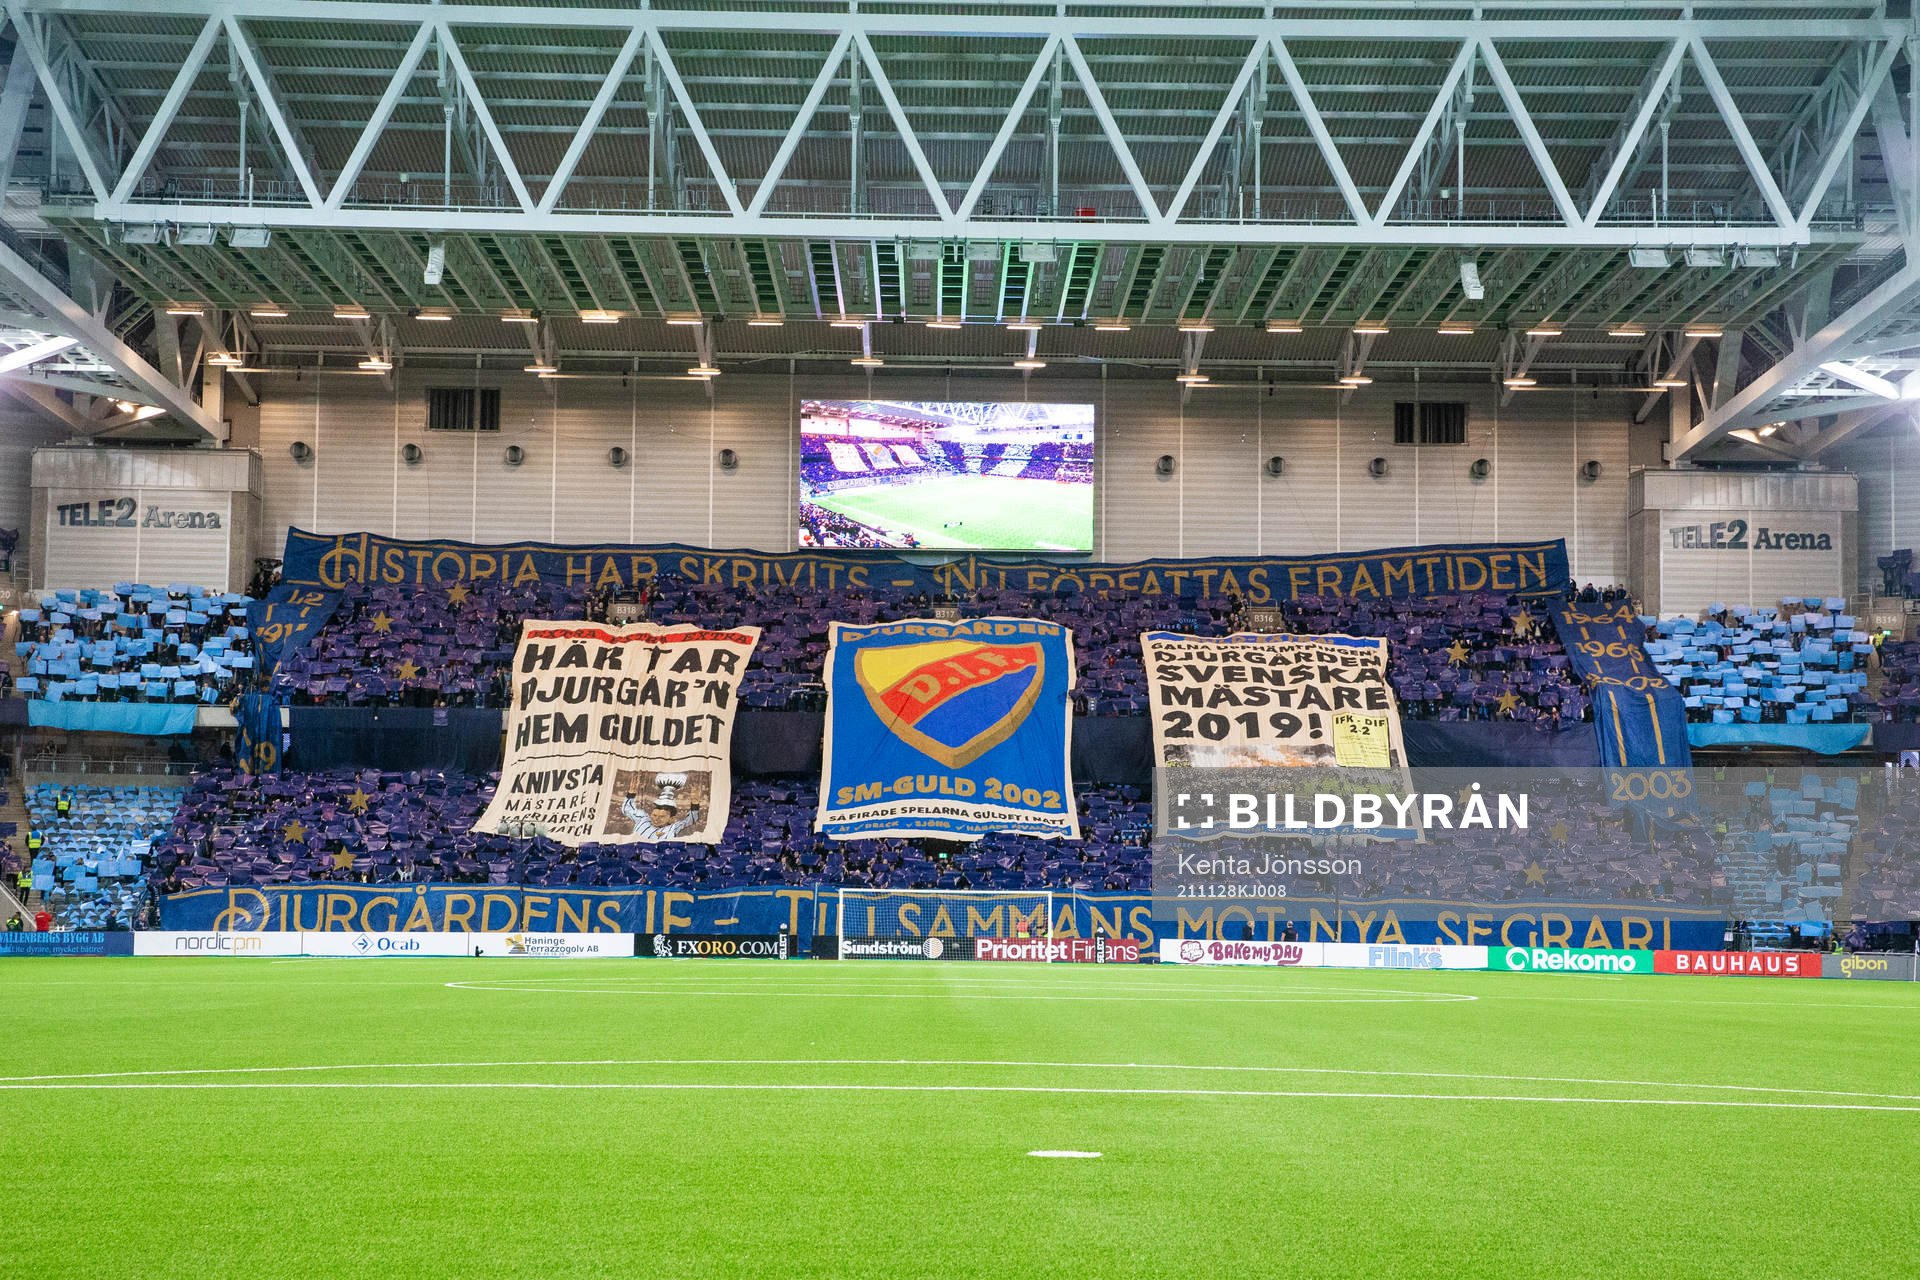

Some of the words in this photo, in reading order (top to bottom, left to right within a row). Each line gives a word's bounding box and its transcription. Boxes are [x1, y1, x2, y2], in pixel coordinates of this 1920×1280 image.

[57, 497, 137, 528] TELE2
[141, 505, 222, 530] Arena
[1669, 519, 1749, 549] TELE2
[1753, 527, 1833, 550] Arena
[565, 556, 659, 591] HAR
[1289, 551, 1548, 602] FRAMTIDEN
[616, 605, 638, 615] B318
[935, 610, 956, 619] B317
[1254, 613, 1274, 623] B316
[1560, 604, 1635, 625] 1964
[1875, 615, 1898, 625] B314
[682, 631, 748, 644] EXTRA
[1151, 642, 1211, 651] GALNA
[521, 639, 625, 673] HÄR
[643, 645, 741, 675] TAR
[1154, 650, 1382, 668] DJURGÅRDEN
[1156, 664, 1383, 687] SVENSKA
[1160, 683, 1391, 712] MÄSTARE
[1161, 710, 1324, 742] 2019!
[1335, 715, 1354, 724] IFK
[1365, 718, 1385, 728] DIF
[514, 712, 589, 752] HEM
[599, 713, 726, 749] GULDET
[510, 763, 604, 795] KNIVSTA
[1611, 769, 1692, 801] 2003
[836, 775, 977, 806] SM-GULD
[984, 776, 1062, 809] 2002
[505, 793, 588, 812] MÄSTARE
[848, 807, 898, 821] FIRADE
[900, 806, 970, 818] SPELARNA
[973, 811, 1022, 821] GULDET
[1033, 816, 1065, 826] NATT
[644, 890, 695, 934] IF
[1177, 905, 1287, 943] MOT
[1309, 908, 1407, 945] NYA
[63, 932, 89, 943] BYGG
[92, 932, 104, 943] AB
[377, 937, 421, 951] Ocab
[524, 937, 565, 946] Haninge
[842, 939, 922, 955] Sundström
[526, 945, 584, 954] Terrazzogolv
[587, 945, 599, 953] AB
[677, 940, 778, 956] FXORO.COM
[976, 938, 1068, 960] Prioritet
[1368, 946, 1444, 968] Flinks
[1531, 949, 1637, 971] Rekomo
[1676, 954, 1800, 973] BAUHAUS
[1840, 955, 1888, 977] gibon
